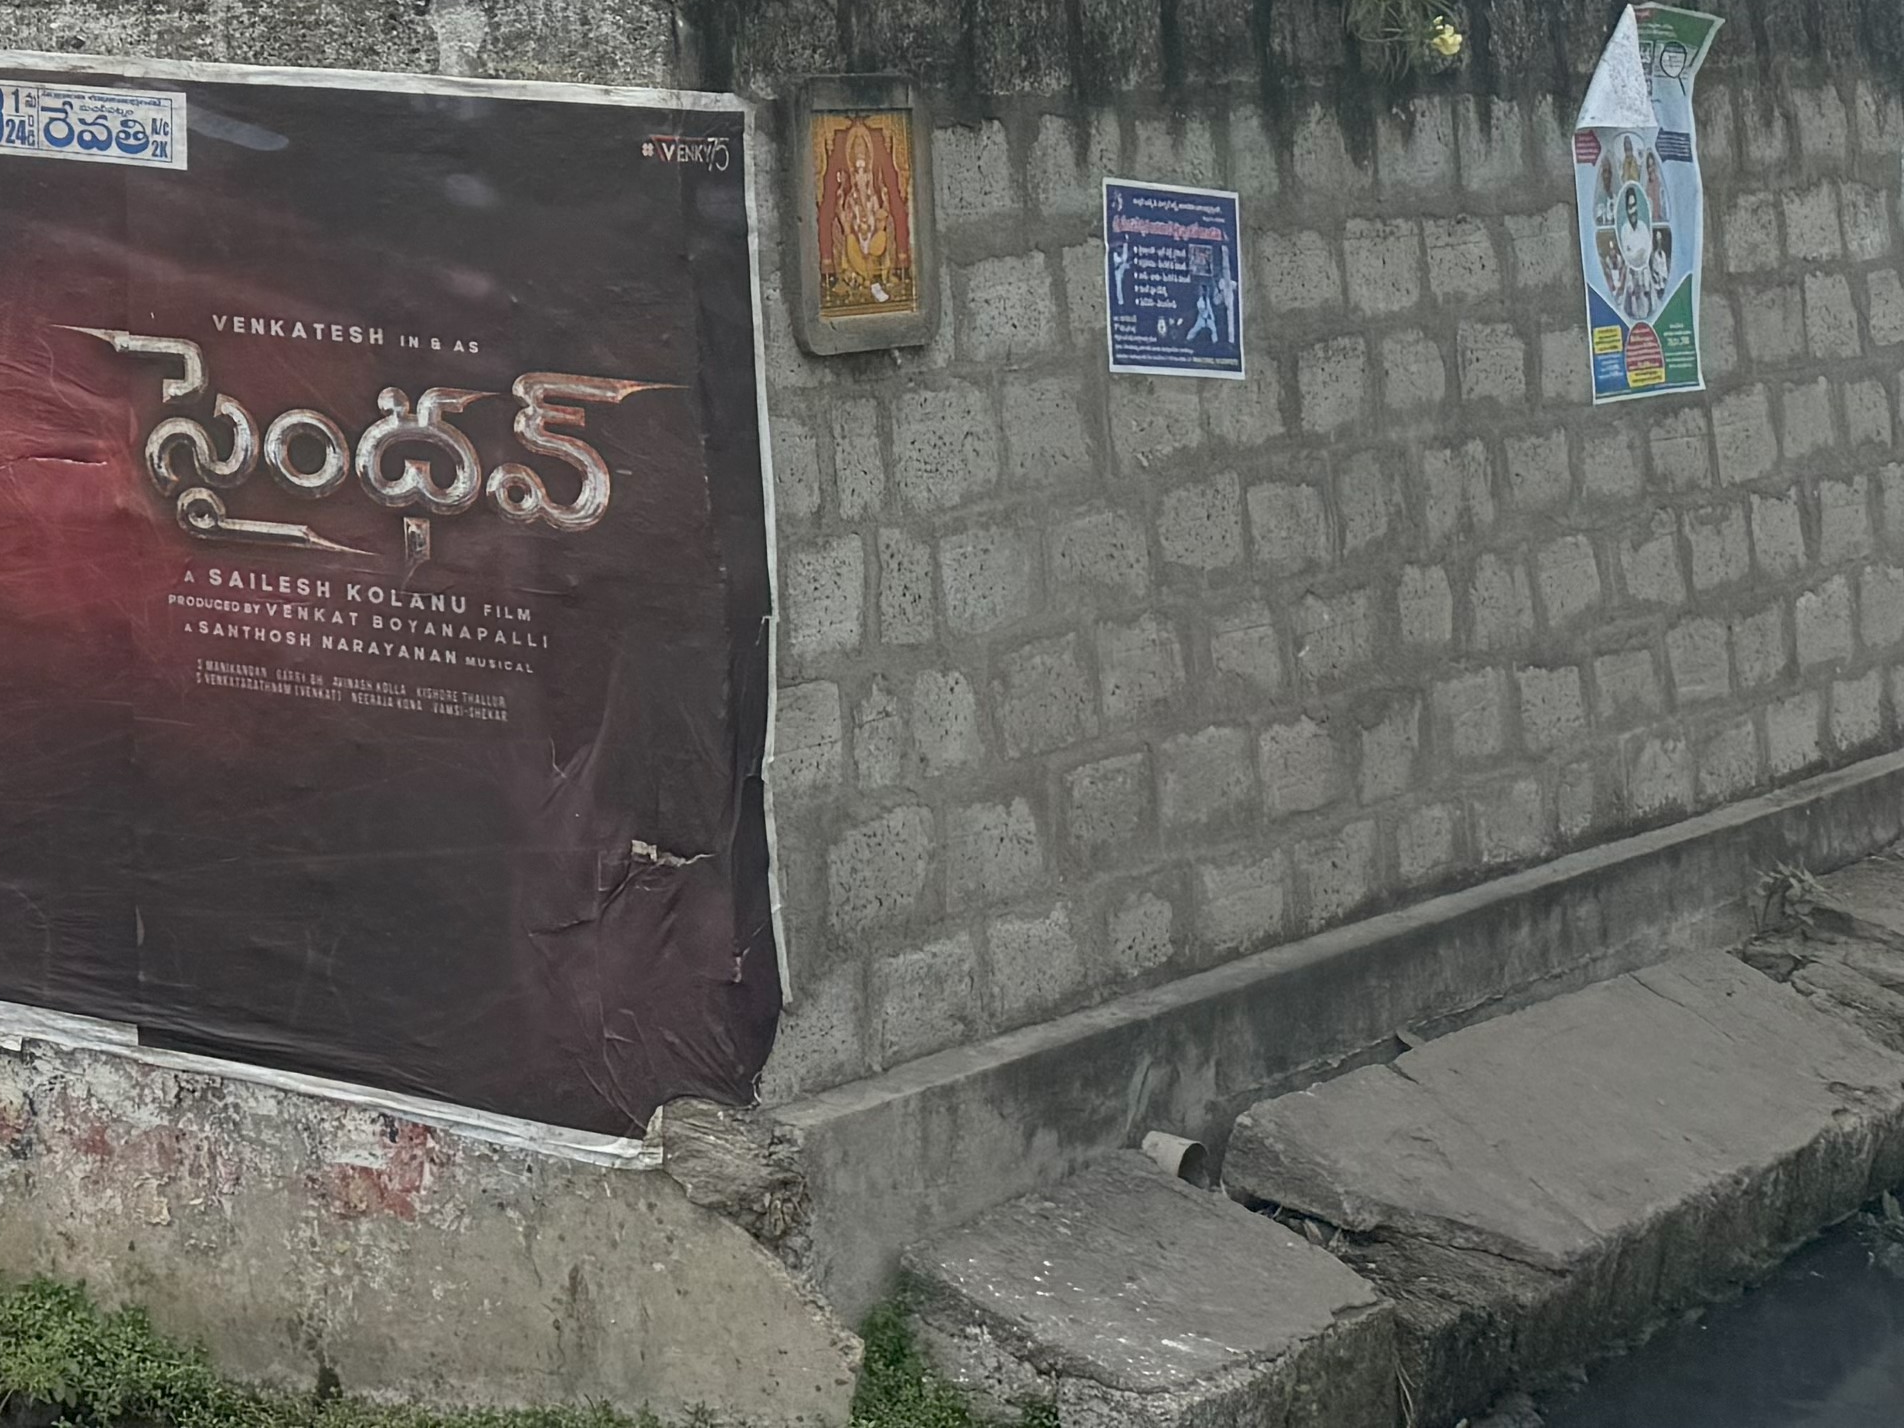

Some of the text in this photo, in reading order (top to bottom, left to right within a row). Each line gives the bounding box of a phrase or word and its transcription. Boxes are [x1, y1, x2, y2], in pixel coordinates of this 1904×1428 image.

[5, 118, 26, 145] 24
[40, 100, 150, 155] రేవతి
[212, 314, 481, 354] VENKATESH IN & AS
[50, 324, 692, 562] సైంధవ్
[168, 593, 549, 649] PRODUCED BY VENKAT BOYANAPALLI
[183, 568, 531, 622] A SAILESH KOLANU FILM
[183, 620, 534, 674] A SANTHOSH NARAYANAN MUSICAL
[206, 660, 267, 679] MANIKANDAN
[375, 681, 406, 696] KOLLA
[417, 687, 458, 703] KISHORE
[351, 692, 393, 708] NEERAJA
[396, 698, 423, 712] KONA
